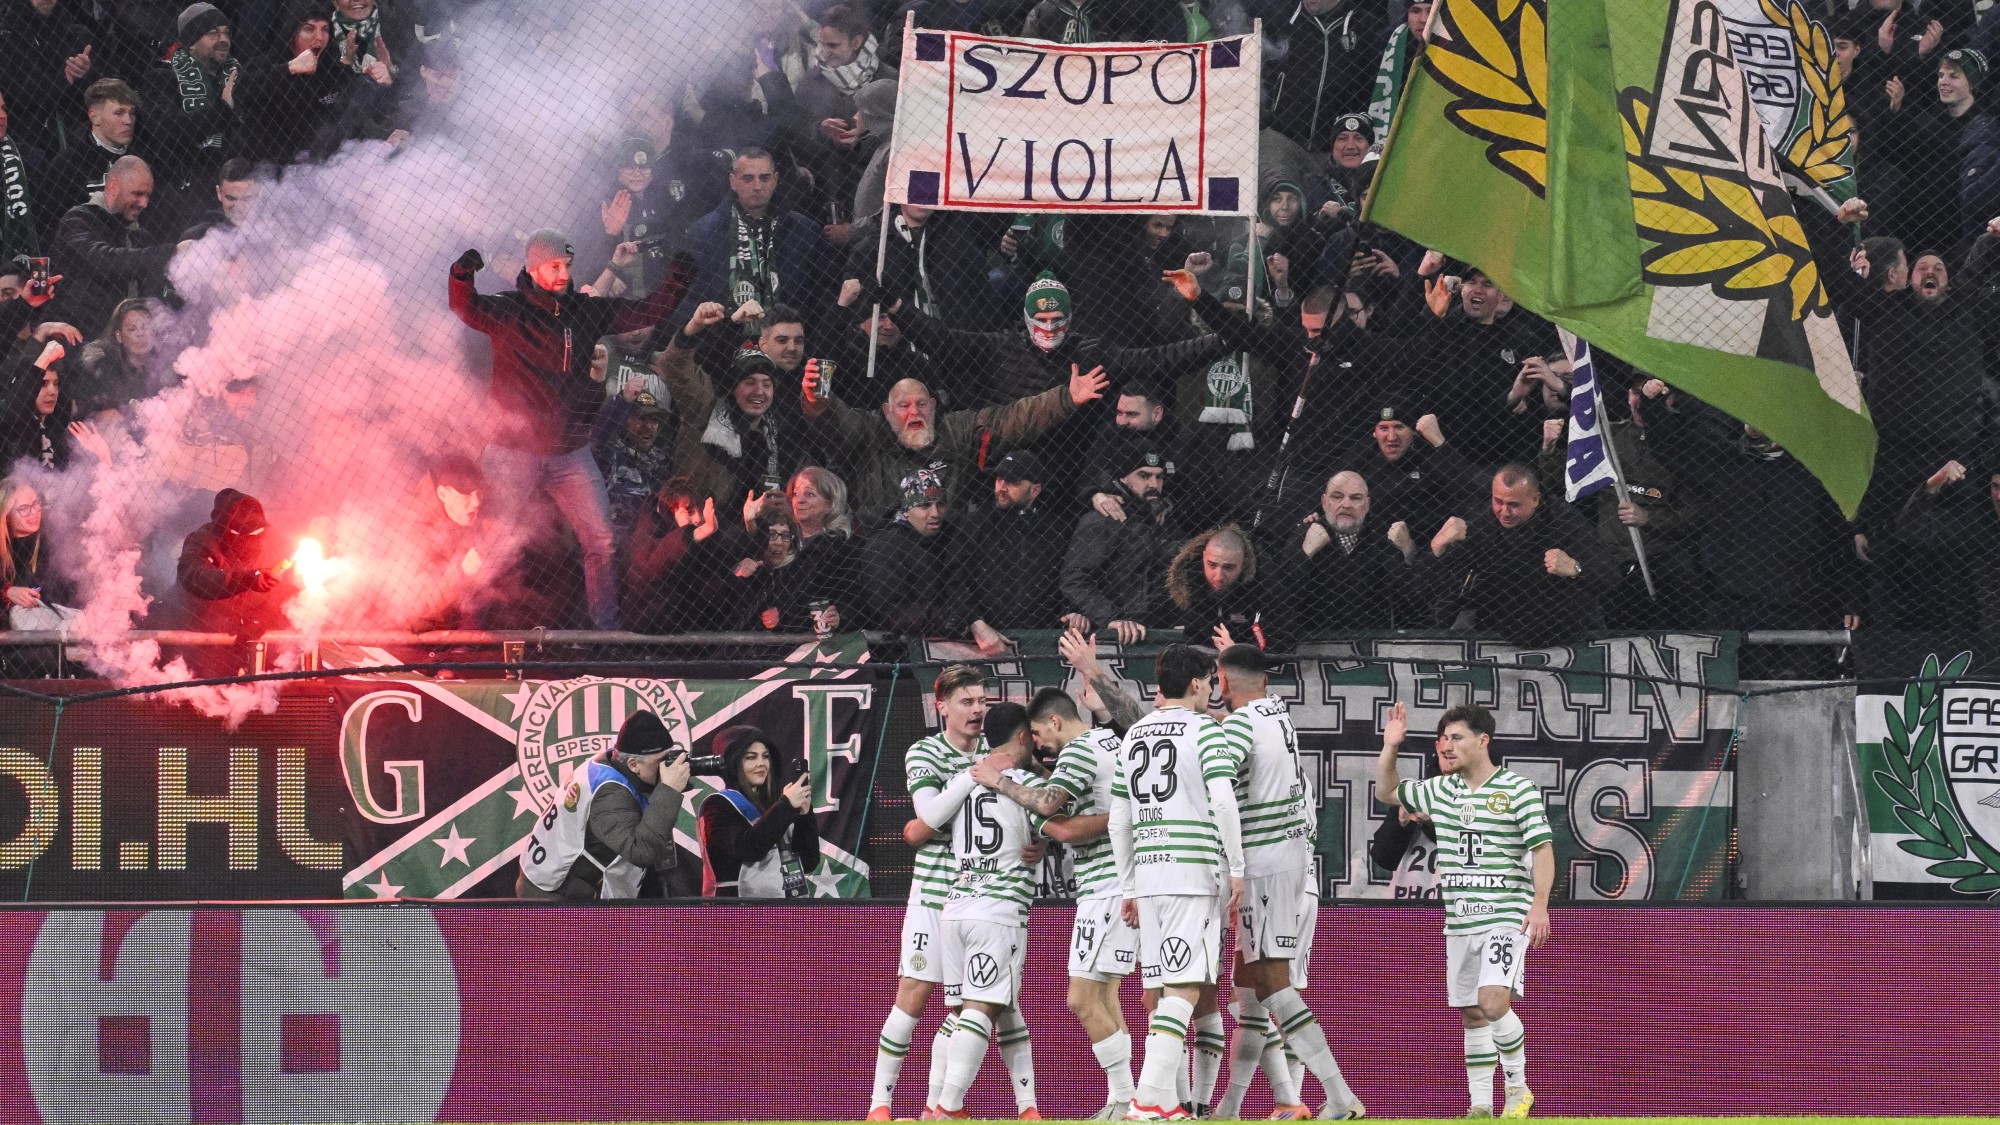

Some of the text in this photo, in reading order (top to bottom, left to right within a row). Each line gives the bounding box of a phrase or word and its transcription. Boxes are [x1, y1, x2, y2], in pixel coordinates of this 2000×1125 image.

[957, 132, 1193, 203] VIOLA
[339, 690, 425, 824] G
[556, 737, 612, 758] BPEST
[793, 684, 872, 813] F
[1128, 739, 1177, 804] 23
[963, 792, 1004, 855] 15
[1075, 926, 1095, 950] 14
[1457, 901, 1494, 915] Midea
[1488, 942, 1513, 965] 36
